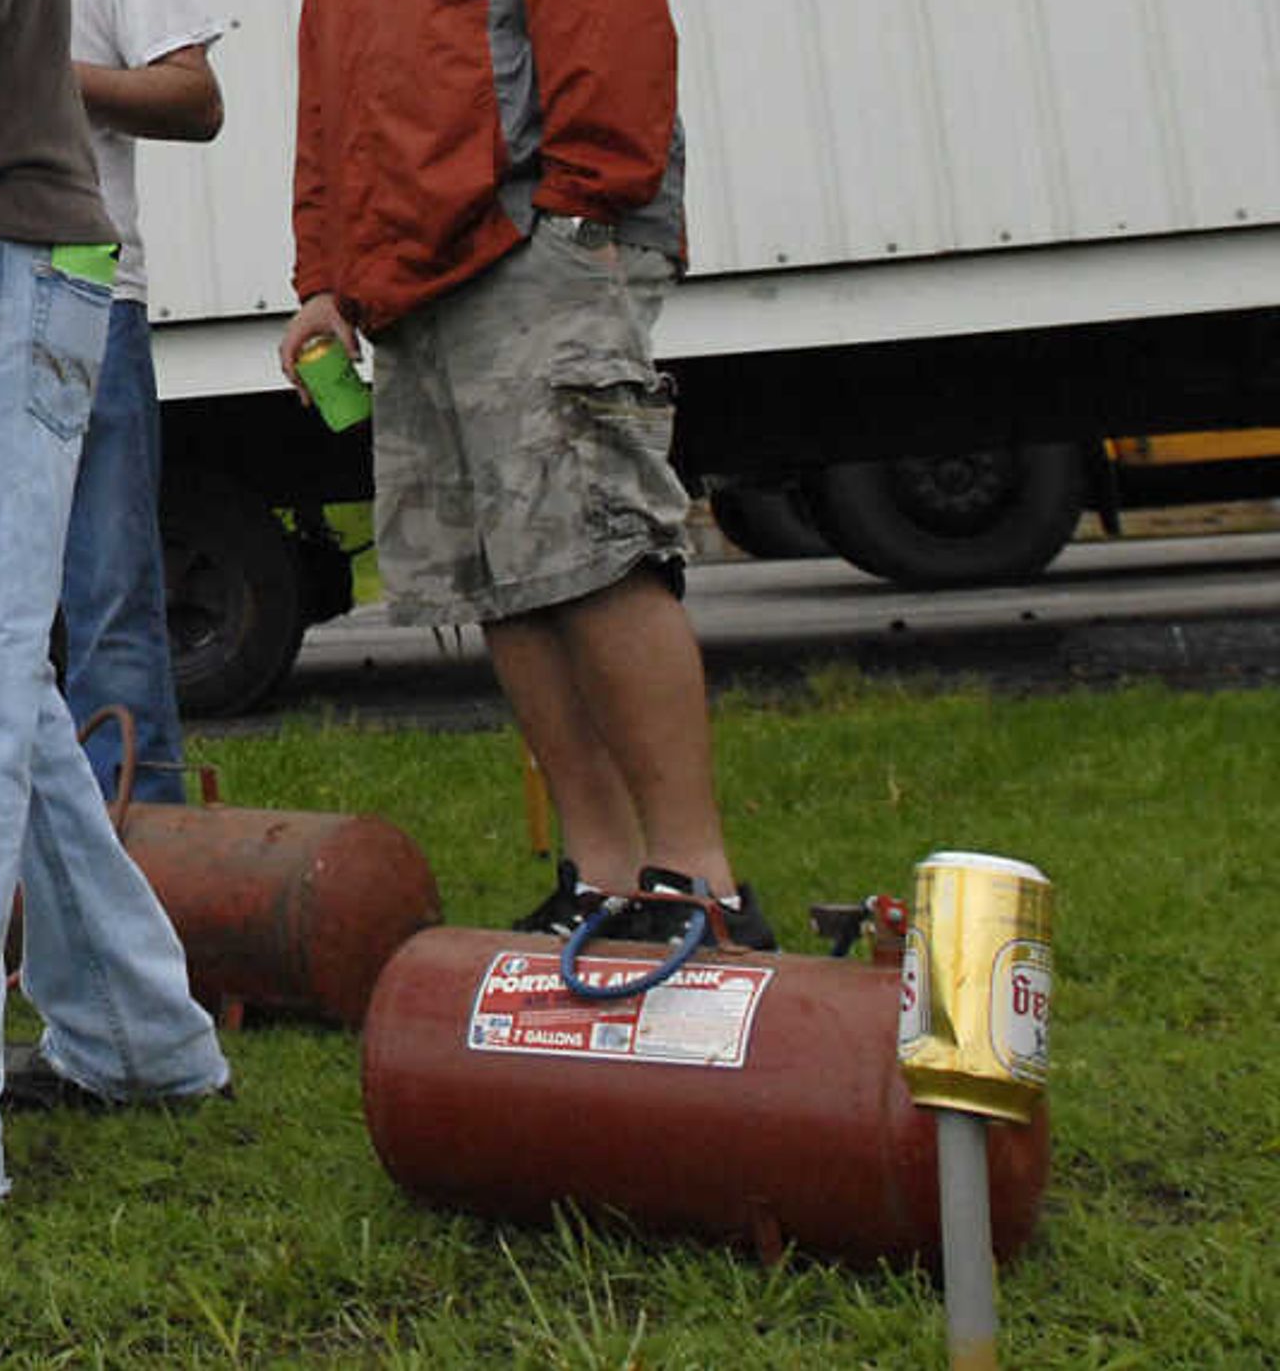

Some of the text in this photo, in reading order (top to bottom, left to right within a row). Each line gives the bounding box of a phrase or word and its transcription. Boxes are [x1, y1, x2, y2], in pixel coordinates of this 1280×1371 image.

[487, 972, 601, 994] PORTALE
[661, 971, 725, 986] ANK
[513, 1029, 523, 1043] 7
[527, 1030, 584, 1046] GALLONS
